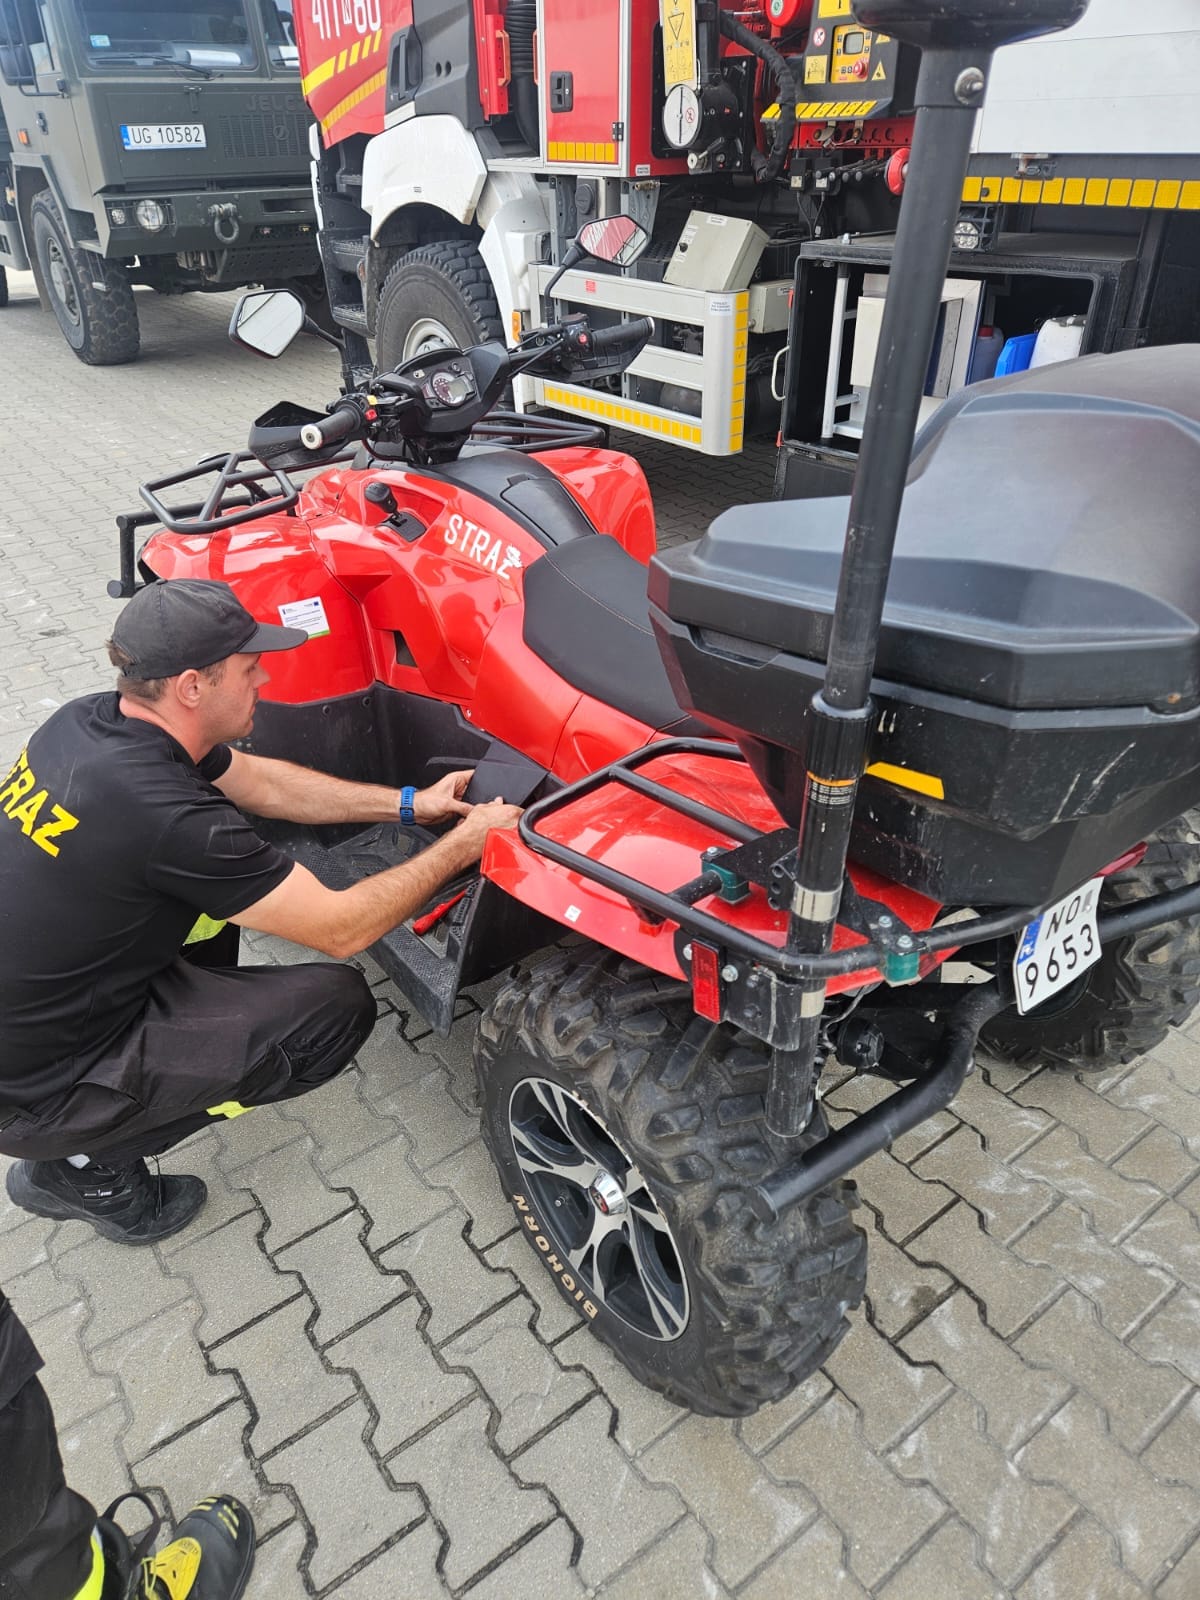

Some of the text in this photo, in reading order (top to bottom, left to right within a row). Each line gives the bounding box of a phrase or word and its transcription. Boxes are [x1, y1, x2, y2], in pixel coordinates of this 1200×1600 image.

[131, 127, 152, 144] UG
[157, 127, 202, 144] 10582
[1046, 895, 1081, 940] NO
[1025, 923, 1094, 998] 9653
[513, 1194, 598, 1320] BIGHORN
